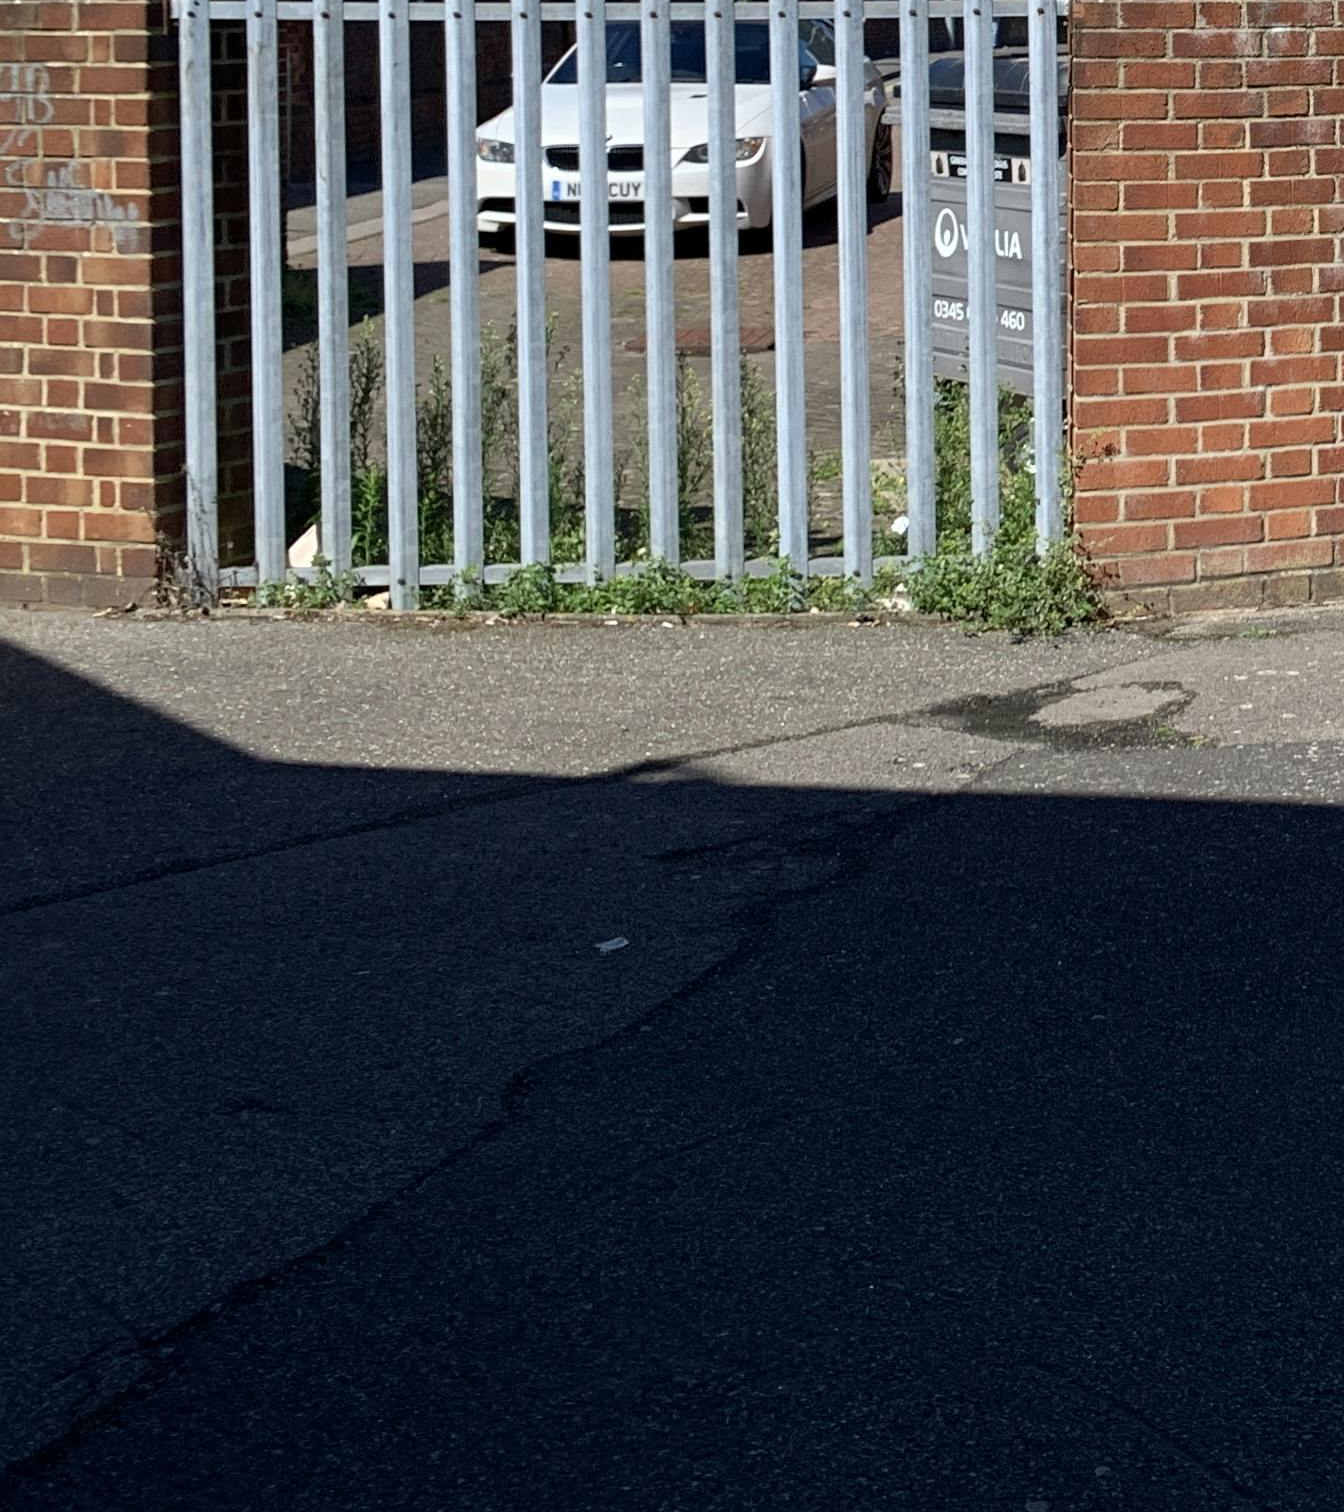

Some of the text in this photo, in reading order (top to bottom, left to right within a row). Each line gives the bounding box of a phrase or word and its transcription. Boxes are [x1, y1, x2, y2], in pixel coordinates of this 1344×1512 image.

[608, 182, 641, 197] CUY
[960, 223, 1022, 259] VLIA
[933, 299, 965, 320] 0345
